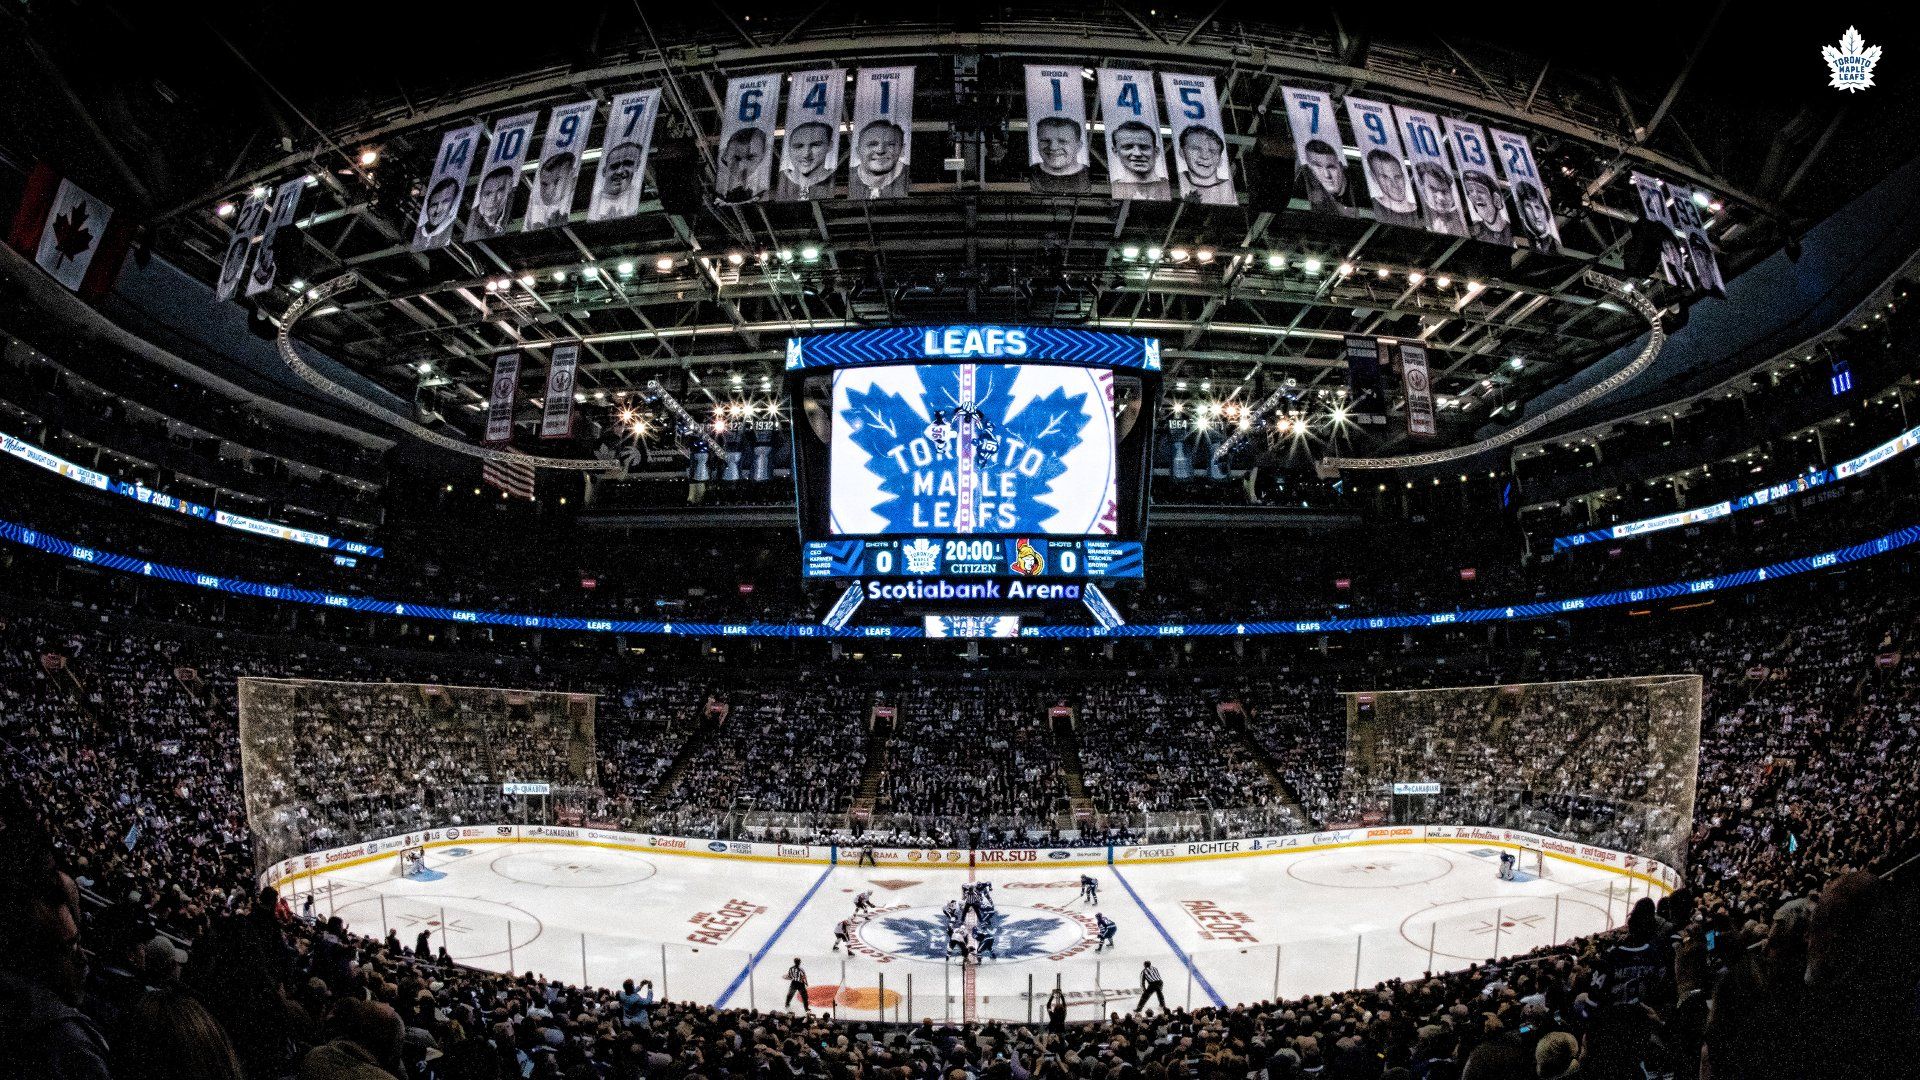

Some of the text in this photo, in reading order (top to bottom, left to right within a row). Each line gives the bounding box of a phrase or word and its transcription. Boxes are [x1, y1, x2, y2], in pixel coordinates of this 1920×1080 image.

[740, 81, 767, 89] BAILEY
[806, 75, 829, 83] KELLY
[803, 83, 827, 115] 4
[880, 81, 889, 114] 1
[1051, 79, 1062, 111] 1
[1117, 83, 1141, 115] 4
[738, 90, 763, 122] 6
[1179, 88, 1206, 120] 5
[1354, 103, 1383, 113] KENNEDY
[623, 104, 643, 137] 7
[1299, 102, 1319, 134] 7
[556, 115, 580, 148] 9
[1363, 113, 1388, 145] 9
[493, 128, 526, 163] 10
[1405, 122, 1440, 157] 10
[1455, 132, 1486, 166] 13
[440, 138, 470, 174] 14
[1502, 143, 1534, 178] 21
[240, 202, 263, 230] 27
[925, 331, 1027, 356] LEAFS
[755, 421, 773, 431] 1932
[931, 426, 943, 440] 36
[888, 434, 1044, 478] TOTO
[1811, 476, 1816, 485] 0
[128, 486, 134, 495] 0
[1770, 484, 1788, 500] 20:00
[152, 492, 170, 508] 20:00
[1748, 496, 1753, 505] 0
[192, 506, 198, 514] 0
[226, 515, 246, 526] Molson
[1624, 523, 1645, 534] Molson
[23, 531, 35, 544] GO
[1573, 535, 1585, 545] GO
[346, 542, 367, 554] LEAFS
[945, 541, 993, 561] 20:00
[1076, 541, 1081, 549] 0
[1878, 539, 1889, 552] GO
[73, 547, 94, 561] LEAFS
[911, 551, 933, 559] TORONTO
[876, 551, 892, 573] 0
[1060, 551, 1076, 573] 0
[1813, 554, 1836, 568] LEAFS
[951, 564, 996, 573] CITIZEN
[197, 575, 218, 588] LEAFS
[1691, 581, 1714, 592] LEAFS
[265, 587, 278, 597] GO
[868, 580, 1080, 599] Scotiabank Arena
[325, 596, 348, 606] LEAFS
[1631, 592, 1643, 601] GO
[1562, 600, 1584, 610] LEAFS
[453, 612, 476, 621] LEAFS
[526, 618, 538, 626] GO
[1370, 619, 1383, 627] GO
[1432, 615, 1455, 623] LEAFS
[587, 622, 611, 630] LEAFS
[724, 626, 747, 634] LEAFS
[799, 627, 813, 635] GO
[1412, 785, 1439, 793] CANADIAN
[545, 829, 575, 837] CANADIAN
[1367, 828, 1413, 838] pizza pizza
[1455, 827, 1500, 840] Tim Hortons
[657, 838, 686, 849] Castrol
[1188, 841, 1239, 855] RICHTER
[1267, 838, 1297, 849] PS4
[1542, 839, 1577, 855] Scotiabank
[326, 846, 365, 863] Scotiabank
[874, 851, 899, 859] RAMA
[981, 850, 1037, 861] MR.SUB
[1139, 848, 1174, 858] PEOPLES
[687, 898, 756, 946] FACE-OFF
[1180, 900, 1259, 943] FACE-OFF
